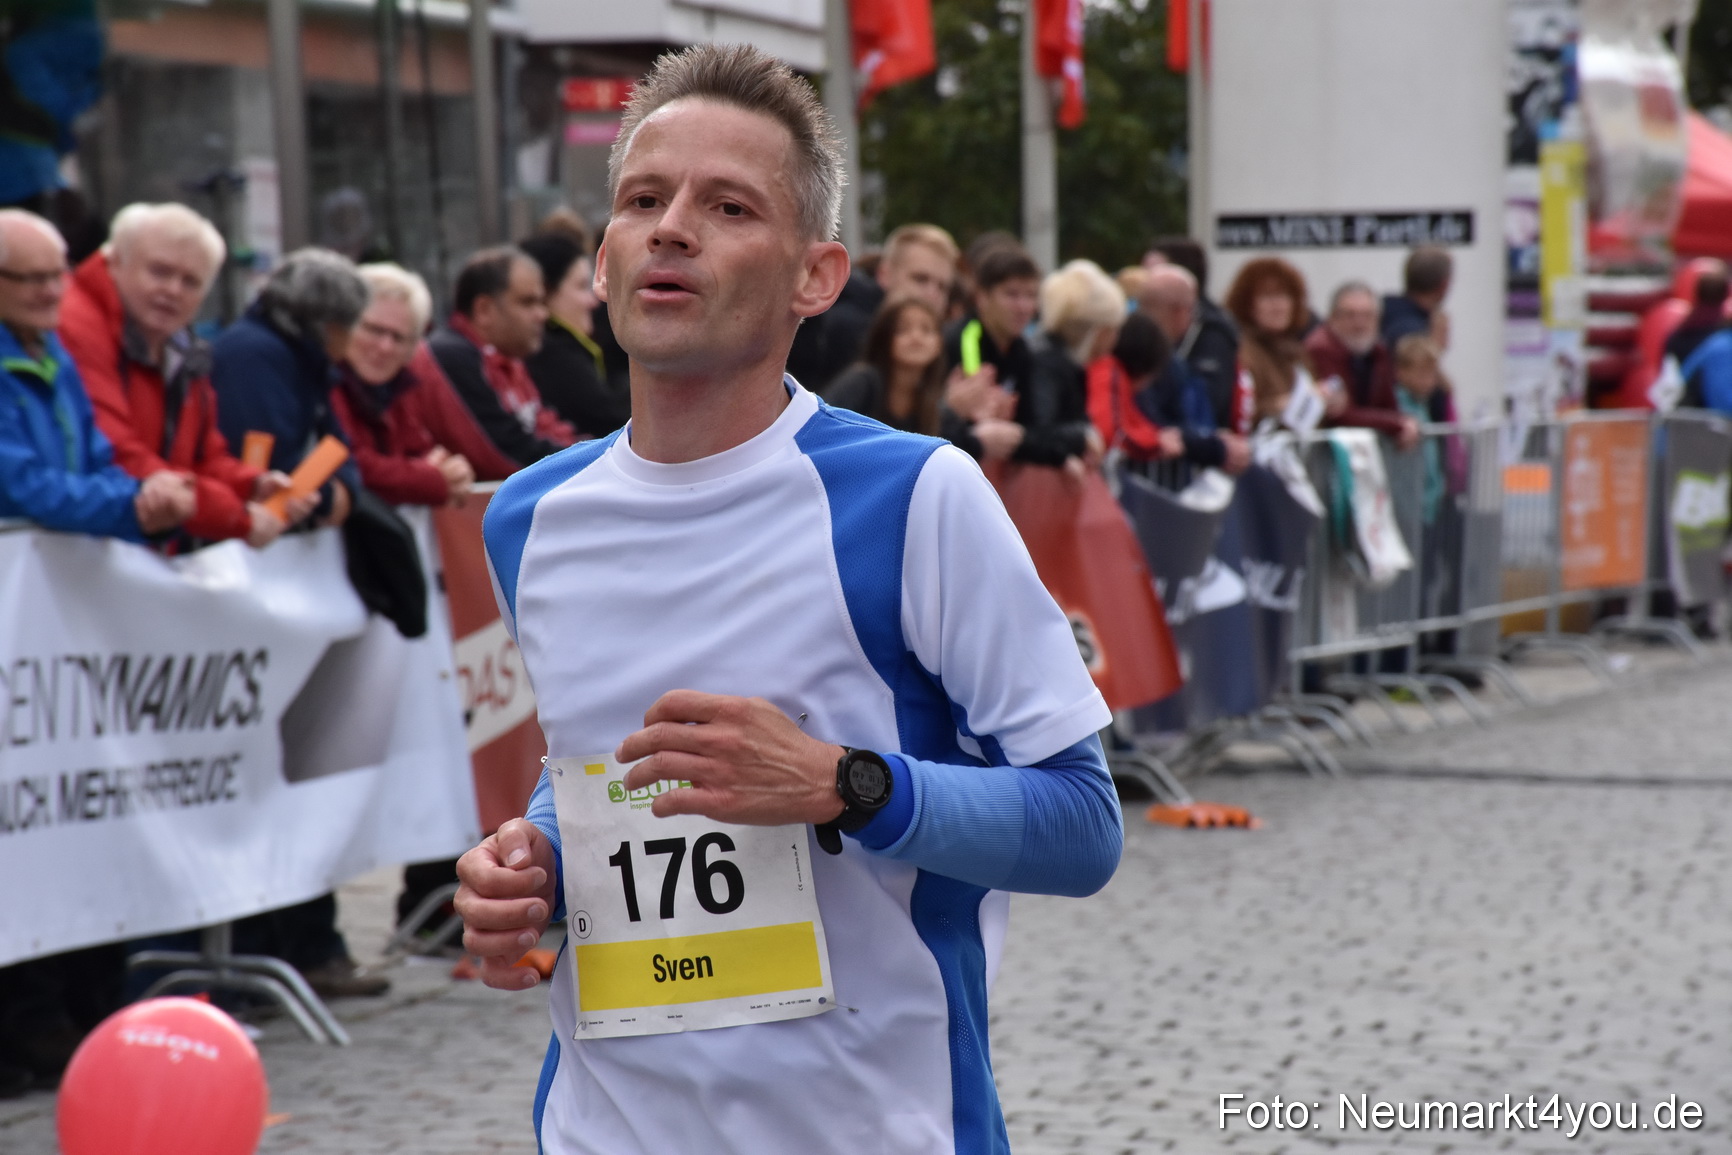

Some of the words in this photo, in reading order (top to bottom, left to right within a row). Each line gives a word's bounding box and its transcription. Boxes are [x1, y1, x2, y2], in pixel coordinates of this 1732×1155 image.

[609, 832, 745, 922] 176
[578, 917, 587, 933] D
[652, 953, 714, 983] Sven
